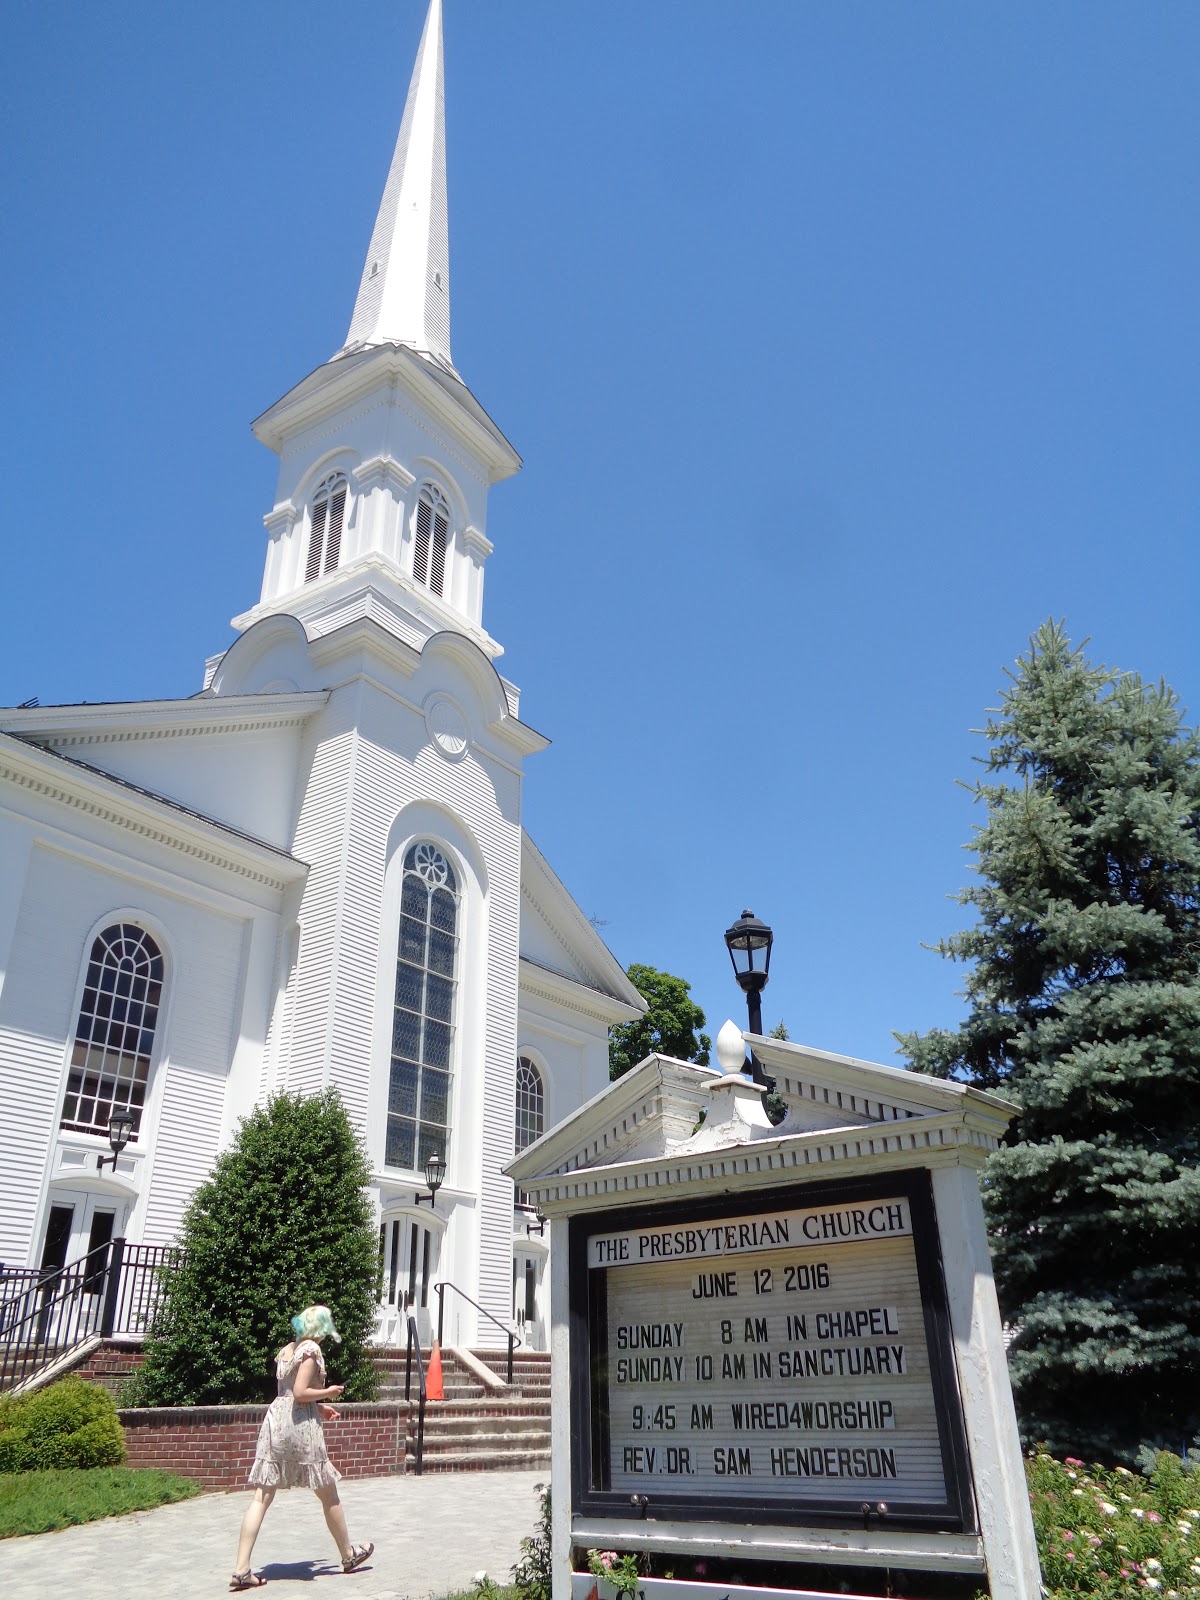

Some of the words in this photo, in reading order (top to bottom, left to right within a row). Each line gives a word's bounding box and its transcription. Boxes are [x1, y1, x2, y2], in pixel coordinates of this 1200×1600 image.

[595, 1238, 629, 1262] THE
[639, 1220, 789, 1258] PRESBYTERIAN
[802, 1204, 904, 1240] CHURCH
[692, 1272, 737, 1299] JUNE
[754, 1269, 772, 1294] 12
[784, 1263, 829, 1291] 2016
[617, 1323, 683, 1350] SUNDAY
[721, 1320, 732, 1345] 8
[744, 1318, 768, 1343] AM
[787, 1315, 806, 1341] IN
[817, 1309, 898, 1339] CHAPEL
[617, 1356, 683, 1383] SUNDAY
[696, 1356, 712, 1381] 10
[722, 1354, 745, 1379] AM
[753, 1352, 770, 1378] IN
[779, 1345, 903, 1377] SANCTUARY
[632, 1406, 675, 1430] 9:45
[690, 1404, 713, 1429] AM
[732, 1400, 892, 1429] WIRED4WORSHIP
[714, 1448, 751, 1475] SAM
[771, 1448, 896, 1478] HENDERSON
